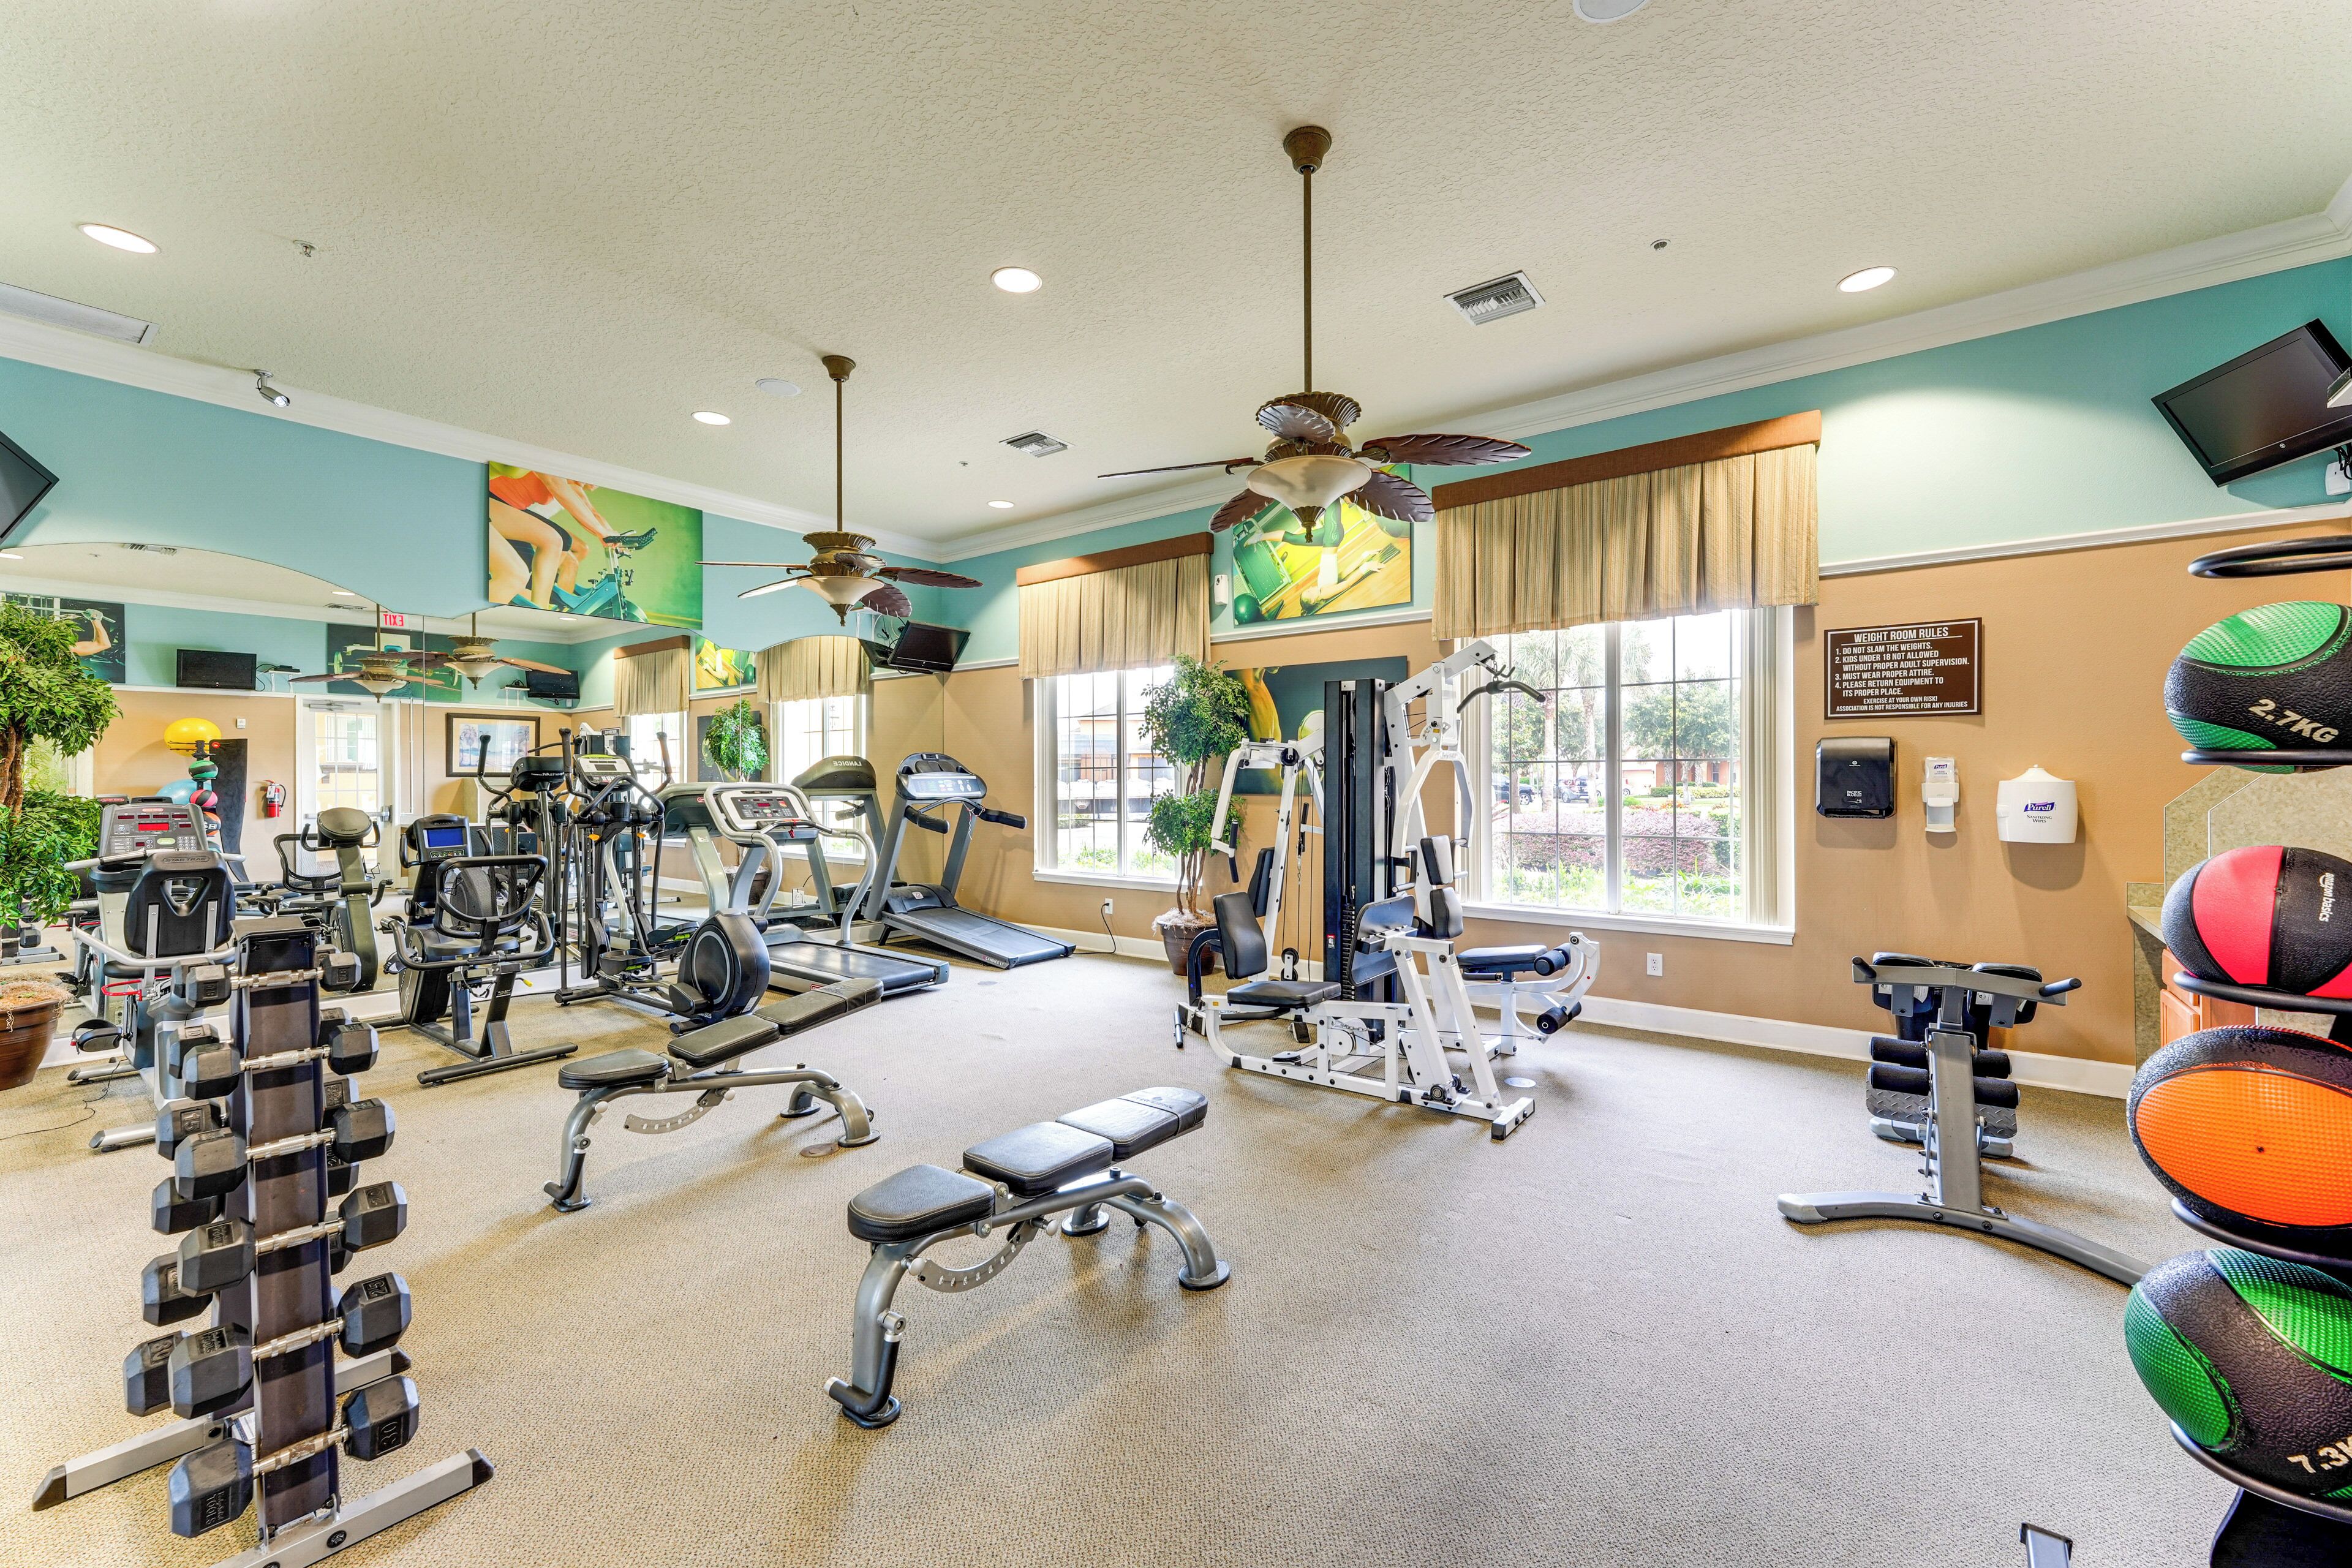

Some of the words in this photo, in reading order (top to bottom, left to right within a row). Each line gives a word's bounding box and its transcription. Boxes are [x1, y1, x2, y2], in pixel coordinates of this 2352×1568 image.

[1854, 631, 1887, 643] WEIGHT
[1890, 629, 1917, 641] ROOM
[1920, 627, 1948, 638] RULES
[1900, 642, 1932, 650] WEIGHTS.
[1907, 650, 1939, 659] ALLOWED
[1922, 658, 1969, 667] SUPERVISION.
[2248, 699, 2339, 742] 2.7KG
[2323, 872, 2335, 897] amazon
[2319, 897, 2335, 922] basics
[184, 1112, 200, 1131] 15
[368, 1281, 388, 1297] 25
[380, 1422, 398, 1445] 30
[2286, 1435, 2352, 1474] 7.3K
[205, 1493, 217, 1525] TOOLS
